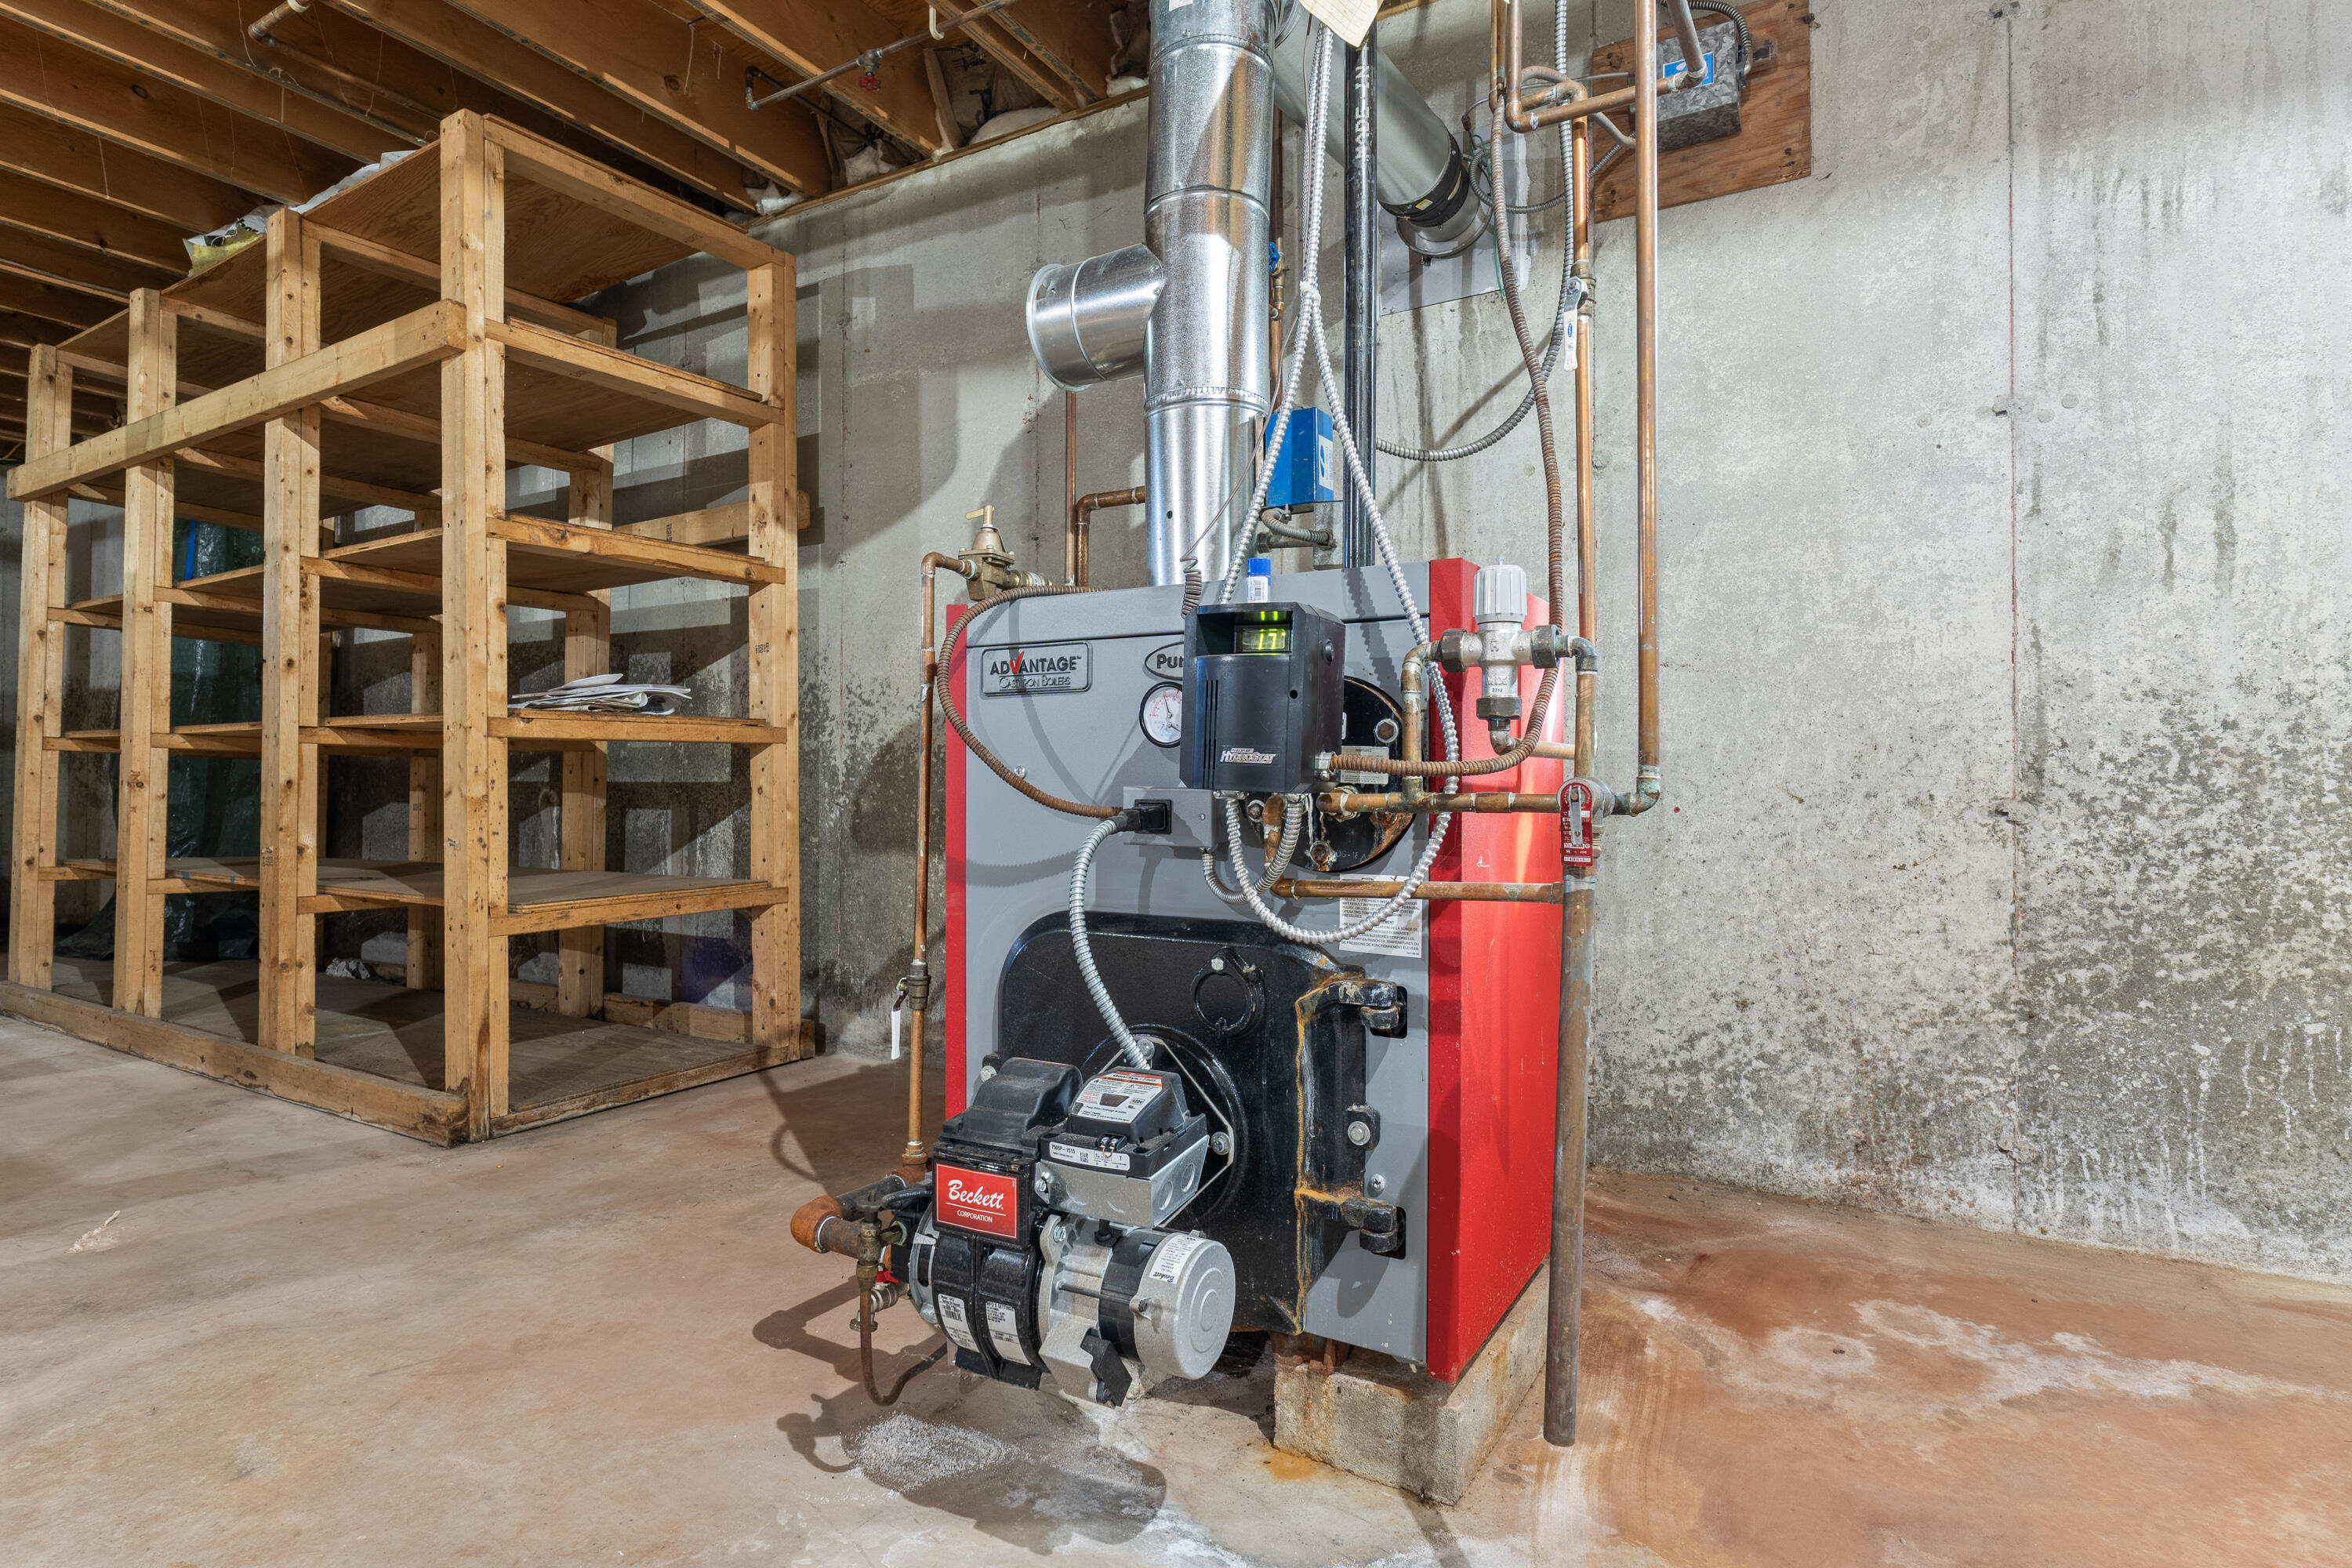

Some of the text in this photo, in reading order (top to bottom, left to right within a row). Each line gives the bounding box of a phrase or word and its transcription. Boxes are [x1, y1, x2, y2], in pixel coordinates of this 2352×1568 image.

[990, 651, 1077, 675] ADVANTAGE
[948, 1179, 1004, 1210] Beckett
[956, 1210, 993, 1223] CORPORATION
